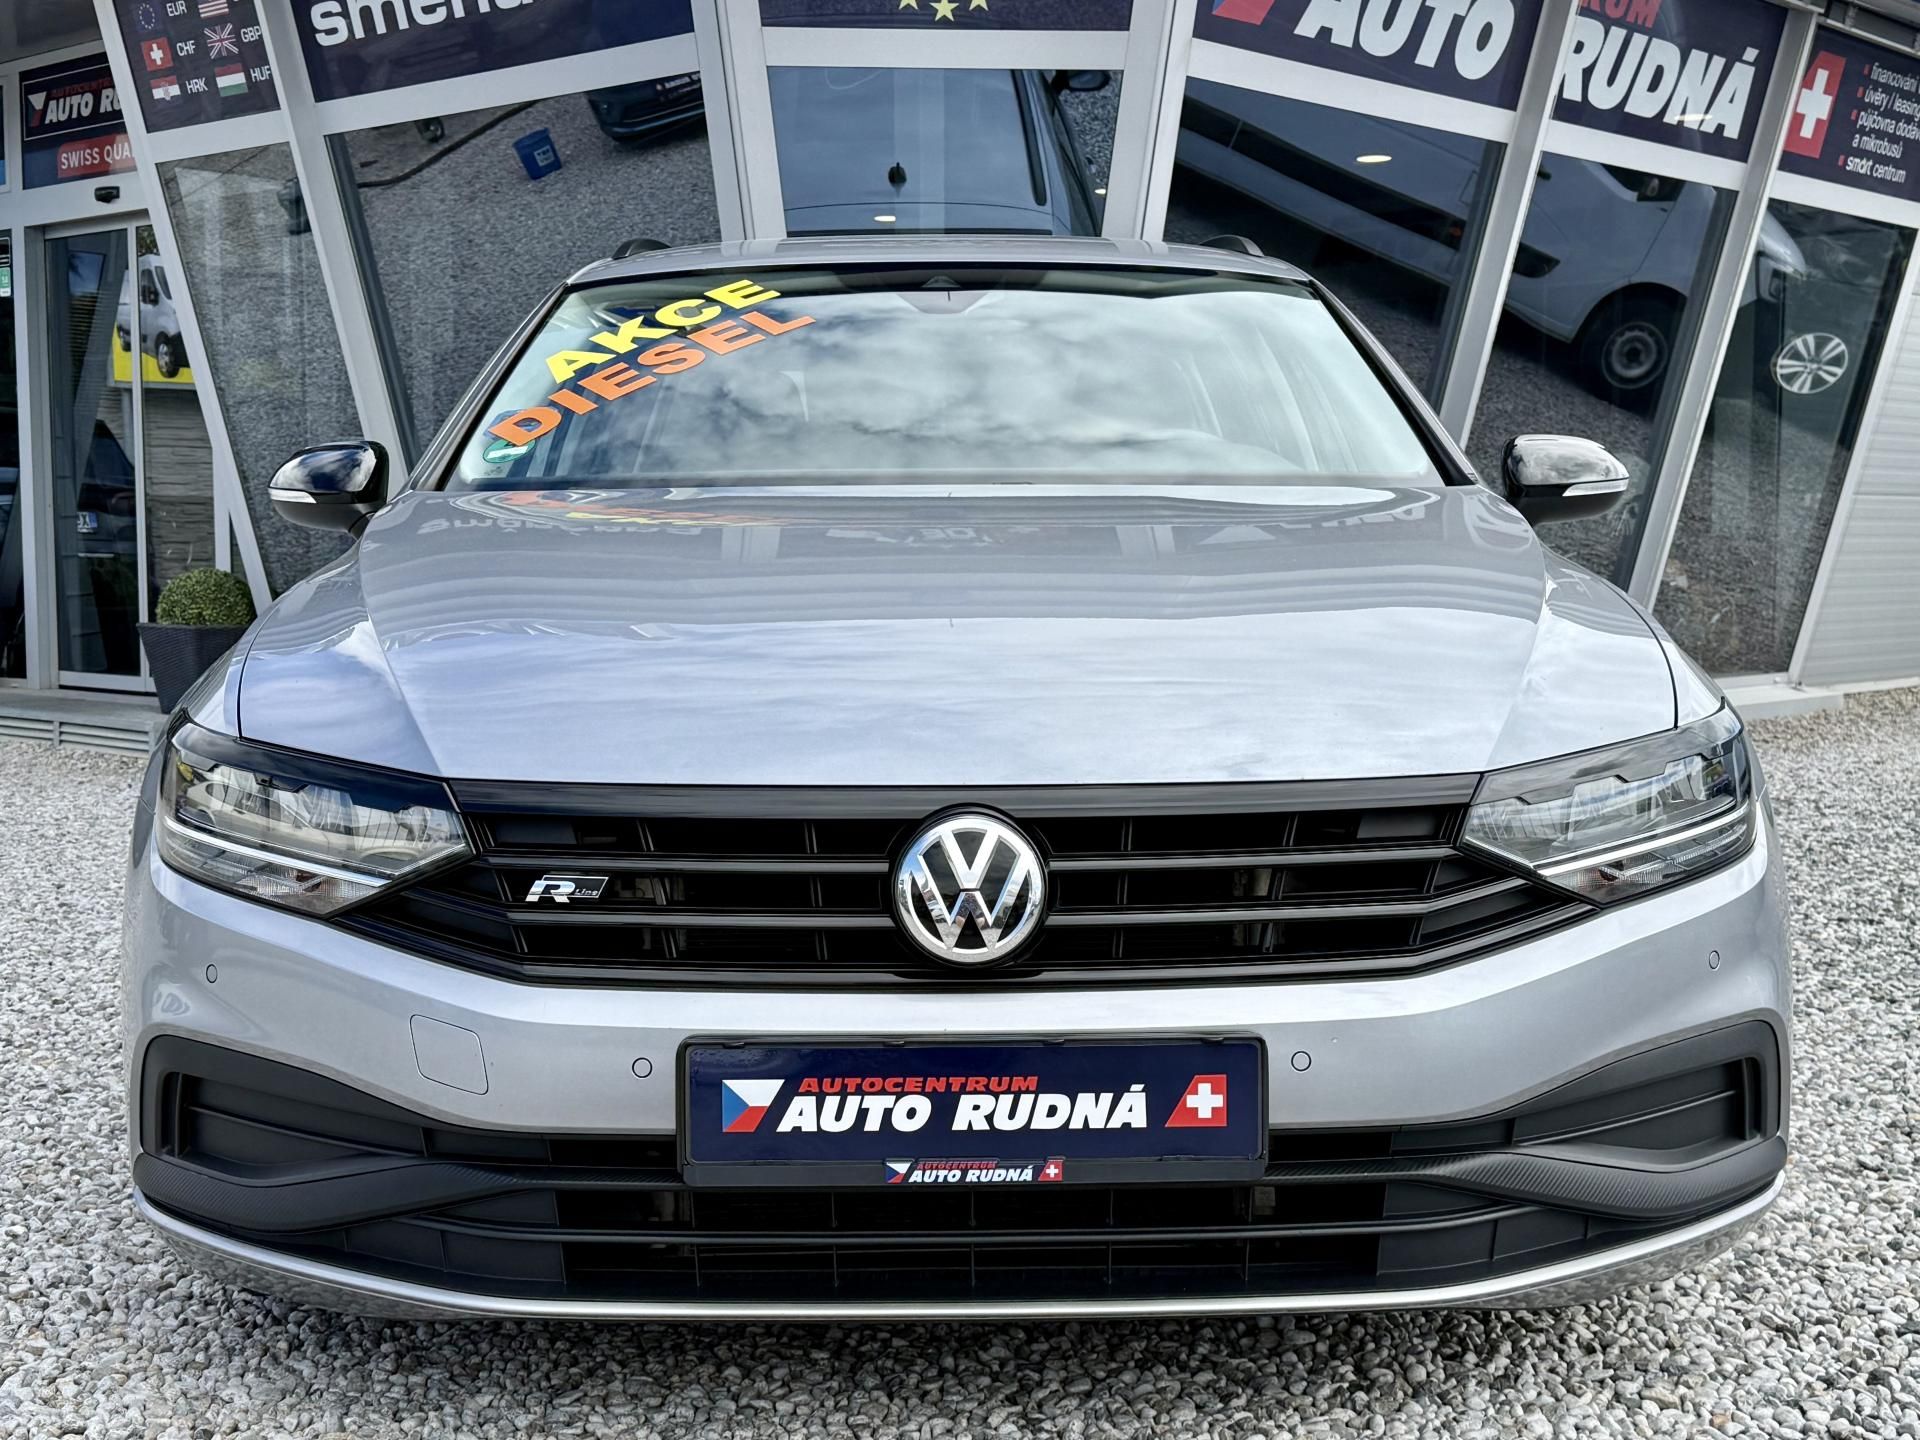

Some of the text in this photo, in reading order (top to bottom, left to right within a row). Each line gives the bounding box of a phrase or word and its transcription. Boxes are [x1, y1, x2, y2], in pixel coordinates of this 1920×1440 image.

[166, 0, 188, 17] EUR
[240, 25, 262, 43] GBP
[1293, 0, 1516, 81] AUTO
[176, 40, 197, 57] CHF
[185, 77, 209, 94] HRK
[250, 65, 271, 83] HUF
[1552, 15, 1761, 141] RUDNÁ
[1870, 62, 1918, 93] financování
[44, 92, 94, 125] AUTO
[1864, 84, 1890, 112] úvěry
[1852, 132, 1903, 159] a mikrobusů
[61, 147, 101, 170] SWISS
[1872, 161, 1907, 184] centrum
[545, 278, 782, 385] AKCE
[488, 310, 817, 447] DIESEL
[796, 1075, 1039, 1094] AUTOCENTRUM
[776, 1084, 1148, 1133] AUTO RUDNÁ
[908, 1164, 1035, 1183] AUTO RUDNÁ
[916, 1160, 998, 1170] AUTOCENTRUM
